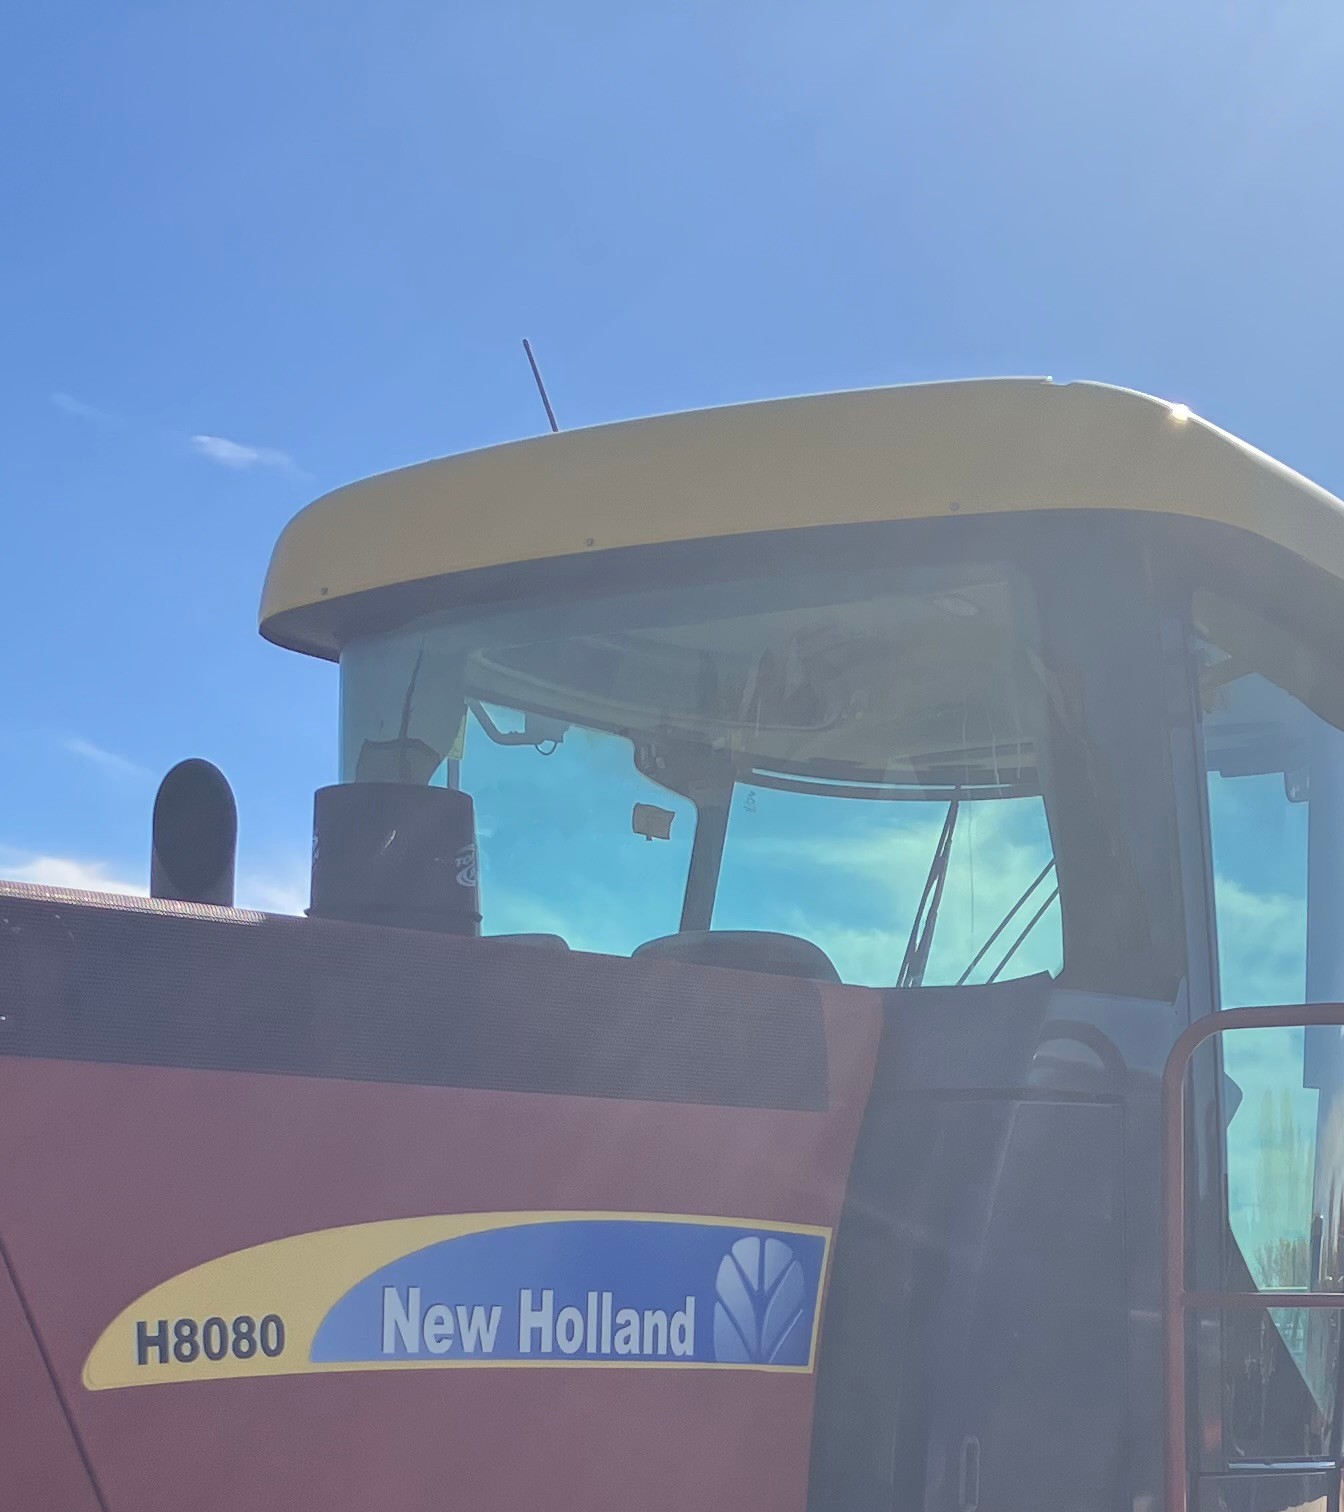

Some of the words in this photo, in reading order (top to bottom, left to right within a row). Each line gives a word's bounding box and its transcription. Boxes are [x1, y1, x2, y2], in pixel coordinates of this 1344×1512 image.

[136, 1313, 286, 1366] H8080
[382, 1286, 503, 1354] New
[518, 1288, 696, 1356] Holland
